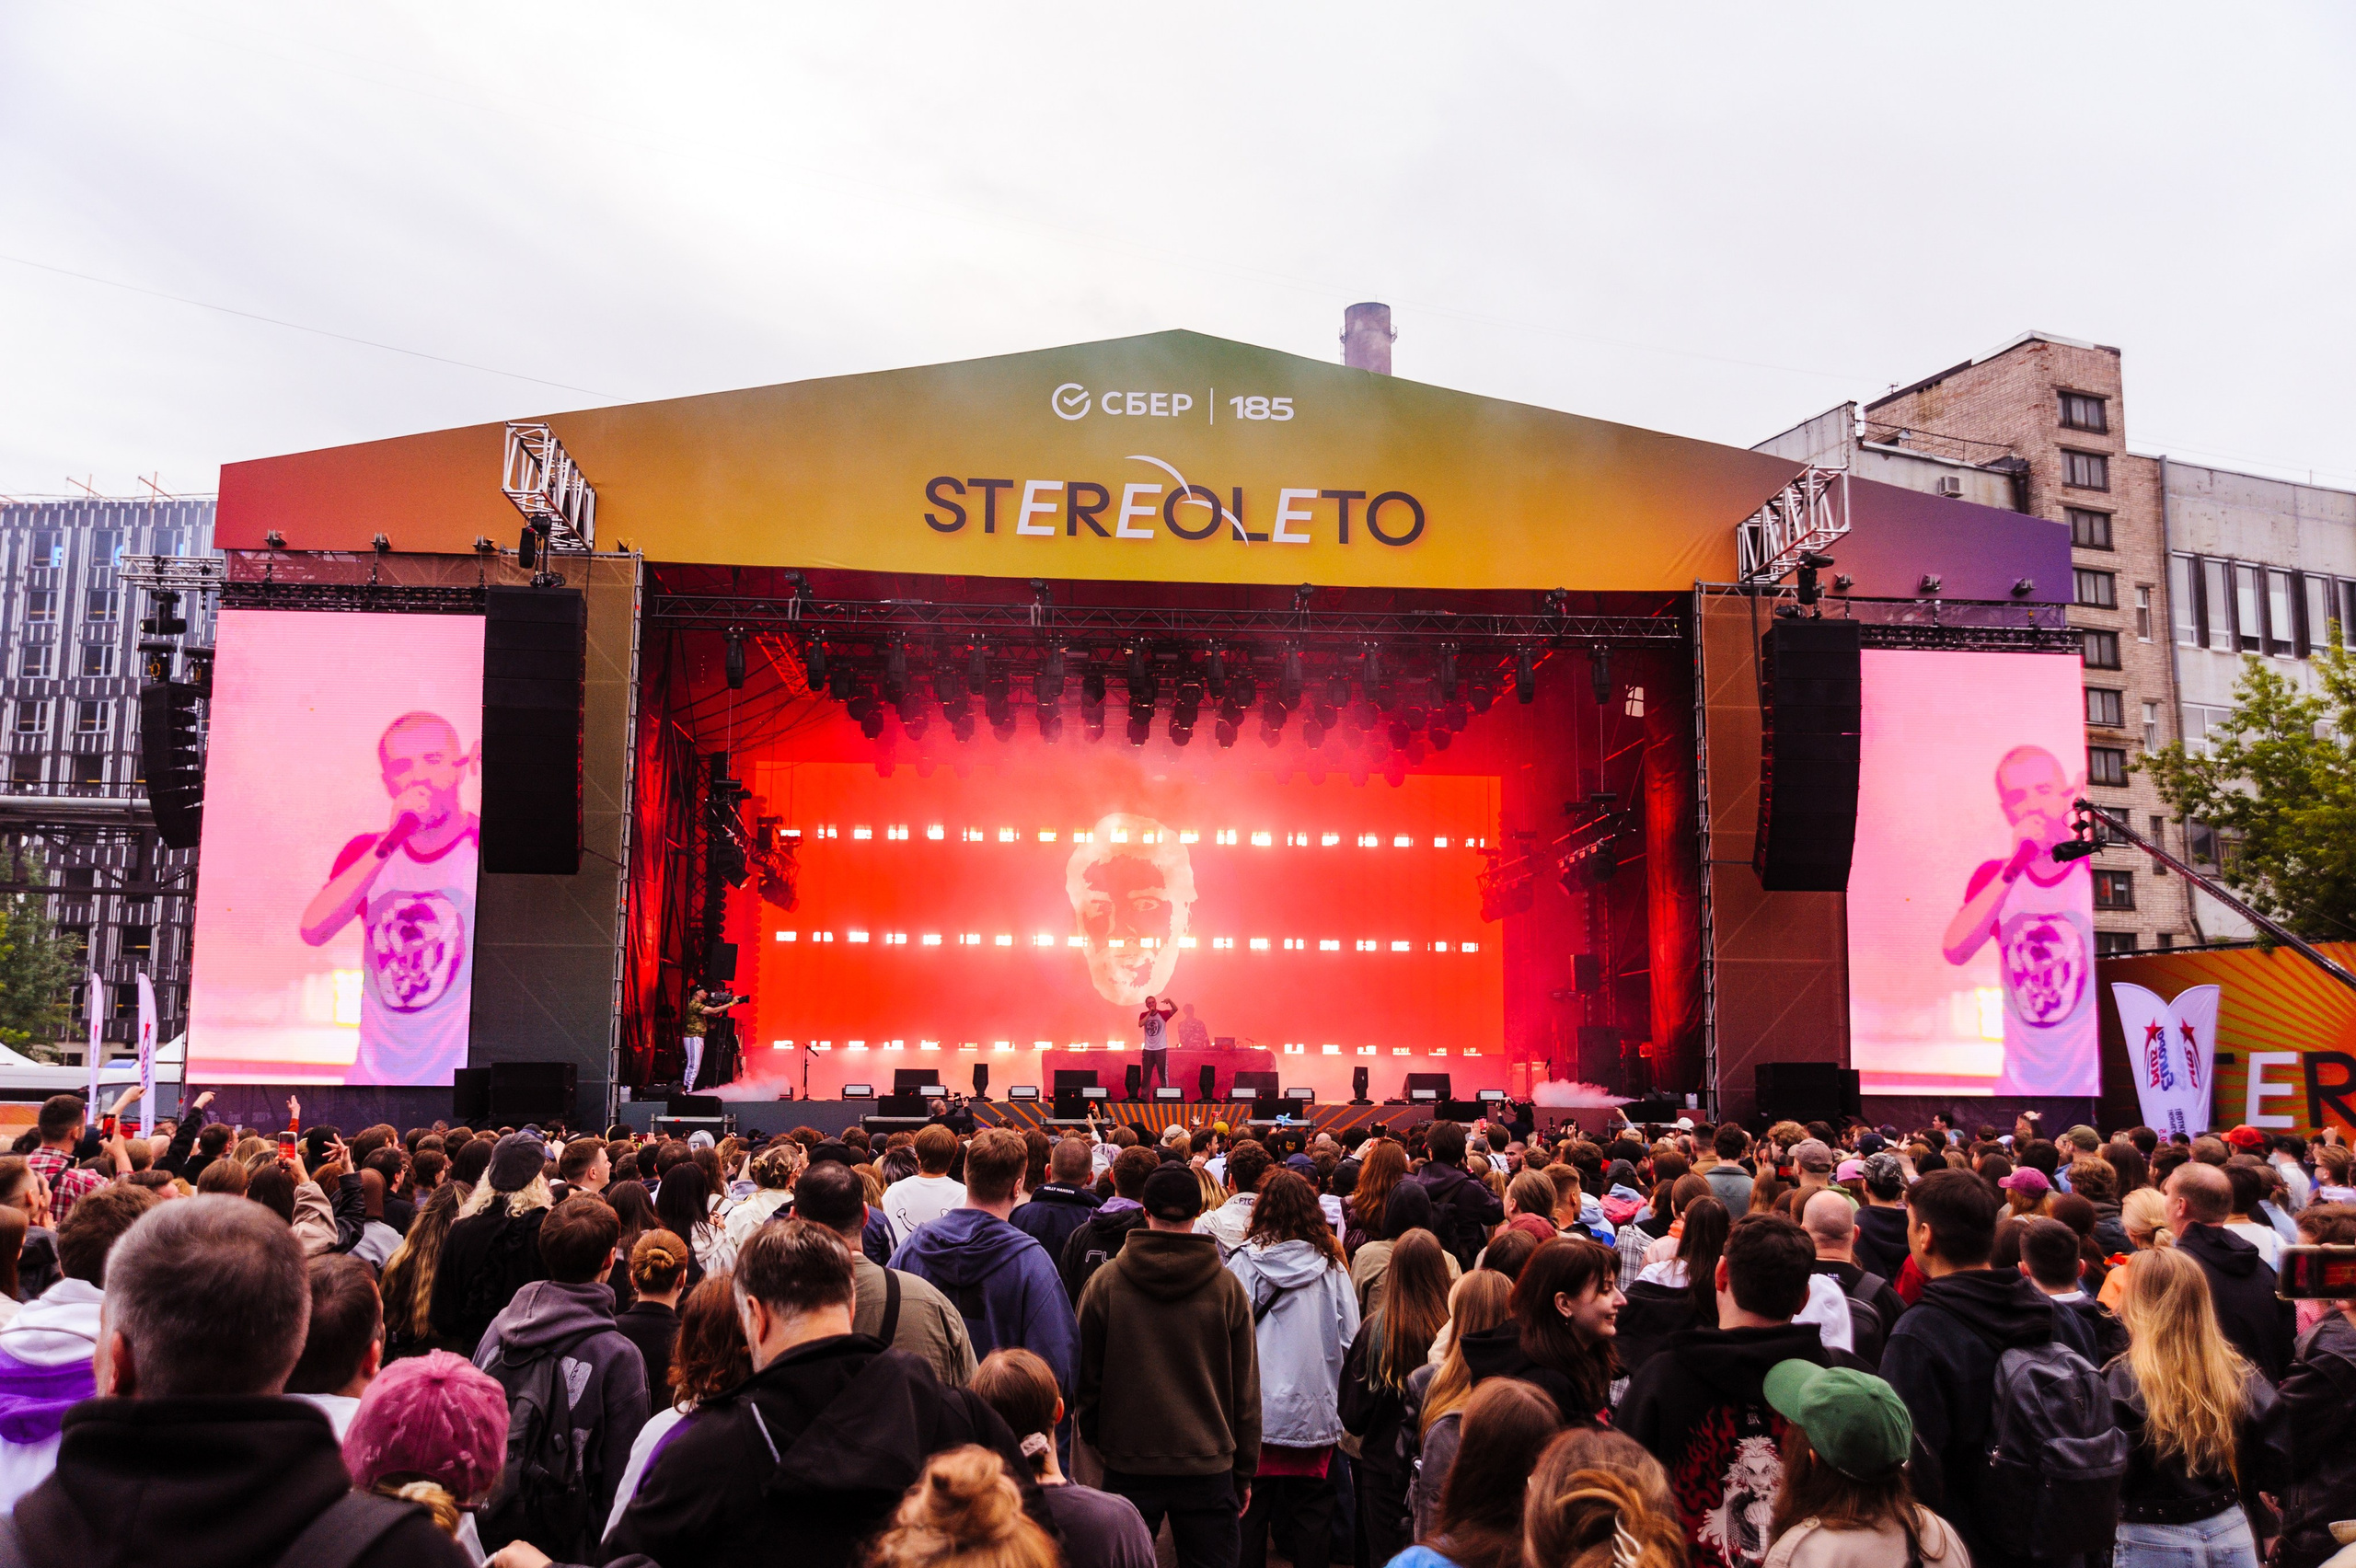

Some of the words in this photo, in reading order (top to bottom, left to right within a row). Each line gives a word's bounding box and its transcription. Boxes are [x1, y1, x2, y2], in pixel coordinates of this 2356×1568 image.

[1101, 391, 1193, 417] СБЕР
[1230, 396, 1295, 421] 185
[923, 476, 1426, 547] STEREOLETO
